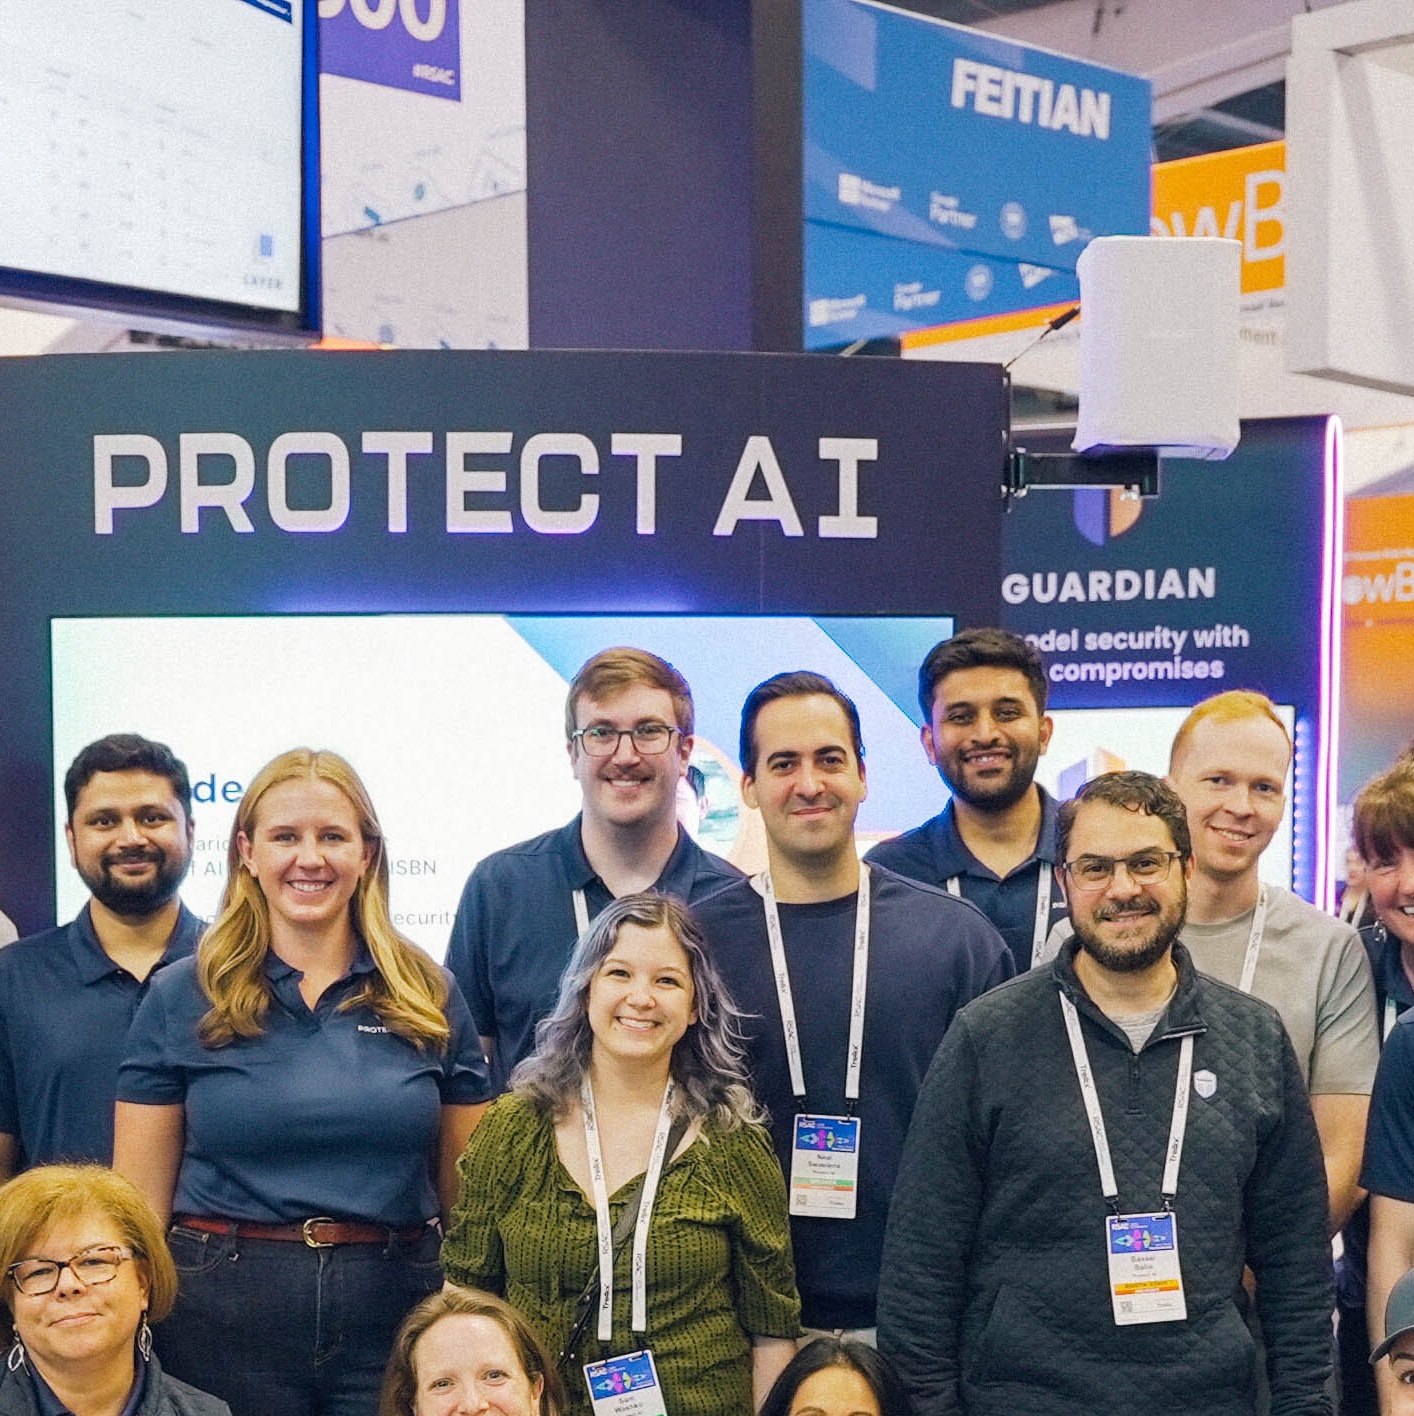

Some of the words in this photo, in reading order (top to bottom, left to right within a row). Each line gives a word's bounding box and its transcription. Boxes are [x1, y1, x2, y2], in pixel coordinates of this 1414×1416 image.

[951, 57, 1111, 141] FEITIAN
[92, 431, 683, 534] PROTECT
[712, 434, 878, 538] AI
[1001, 567, 1216, 604] GUARDIAN
[1085, 625, 1188, 655] security
[1193, 623, 1250, 649] with
[1049, 656, 1225, 687] compromises
[357, 1025, 388, 1034] PROTE
